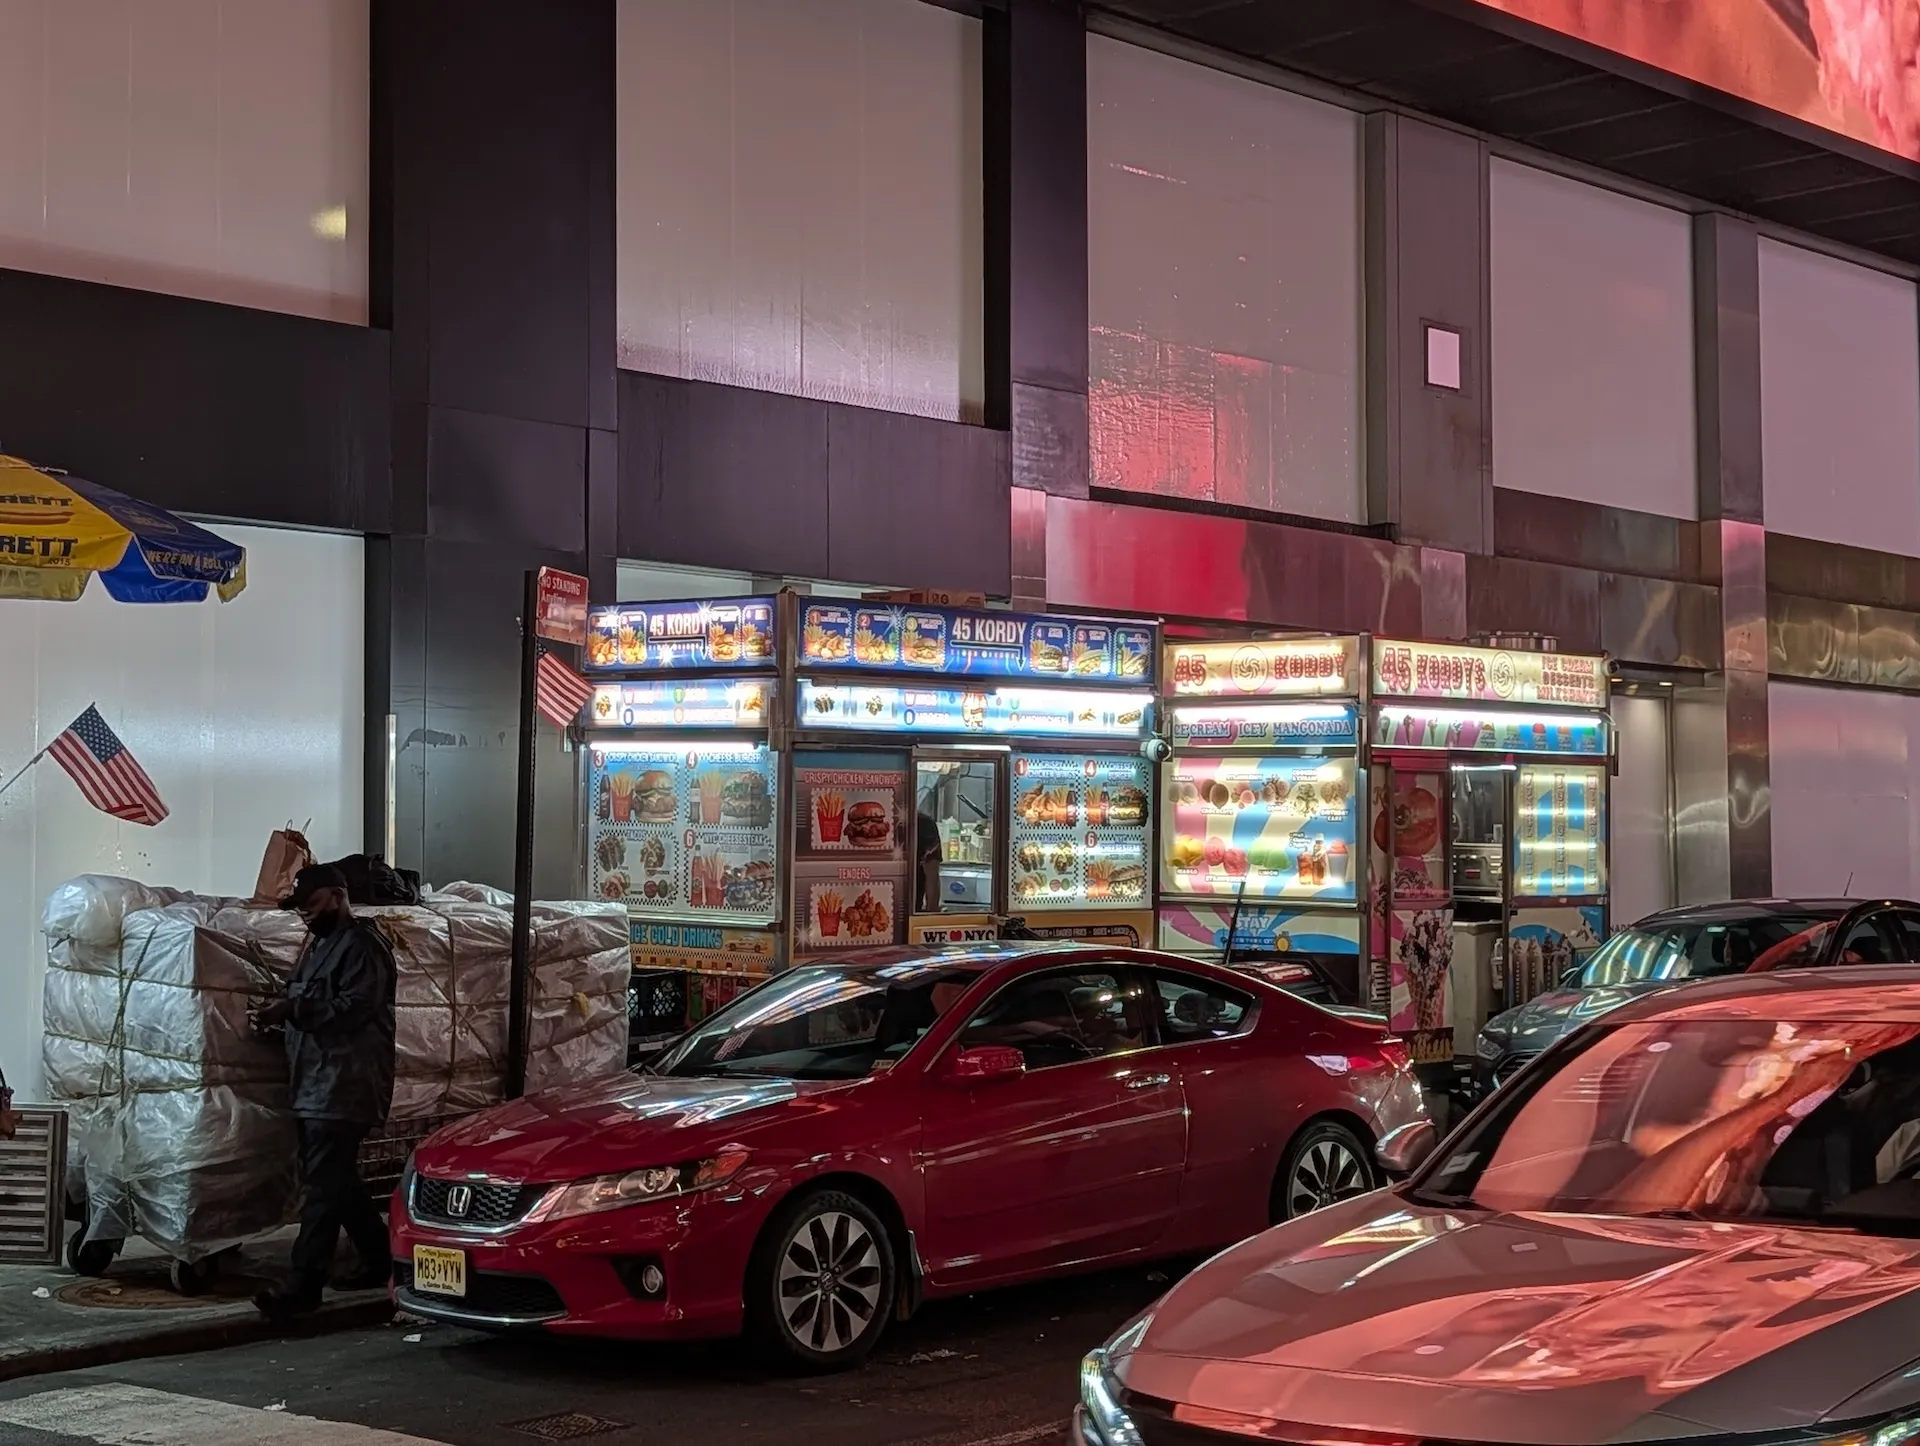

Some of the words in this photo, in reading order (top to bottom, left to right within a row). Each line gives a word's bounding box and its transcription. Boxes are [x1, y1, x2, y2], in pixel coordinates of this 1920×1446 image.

[541, 575, 551, 589] NO
[552, 576, 581, 596] STANDING
[649, 614, 665, 636] 45
[666, 611, 708, 636] KORDY
[951, 616, 972, 641] 45
[974, 617, 1028, 644] KORDY
[1174, 654, 1207, 686] 45
[1274, 652, 1349, 680] KORDY
[1380, 646, 1412, 692] 45
[1416, 653, 1486, 692] KORDYS
[1541, 655, 1558, 671] ICE
[1560, 656, 1594, 675] CREAM
[1542, 671, 1595, 689] DESSERTS
[1174, 722, 1187, 737] CE
[1188, 721, 1231, 738] CREAM
[1238, 721, 1268, 737] ICEY
[1272, 719, 1353, 737] MANGONADA
[687, 752, 696, 767] 4
[804, 771, 830, 784] CRISPY
[833, 772, 864, 785] CHICKEN
[865, 773, 902, 785] SANDWICH
[686, 832, 694, 847] 6
[719, 834, 765, 847] CHEESESTEAK
[1087, 834, 1095, 847] 6
[838, 867, 871, 880] TENDERS
[1236, 915, 1270, 929] STAY
[630, 923, 648, 945] ICE
[649, 924, 680, 947] COLD
[680, 925, 724, 950] DRINKS
[923, 930, 948, 943] WE
[964, 929, 996, 941] NYC
